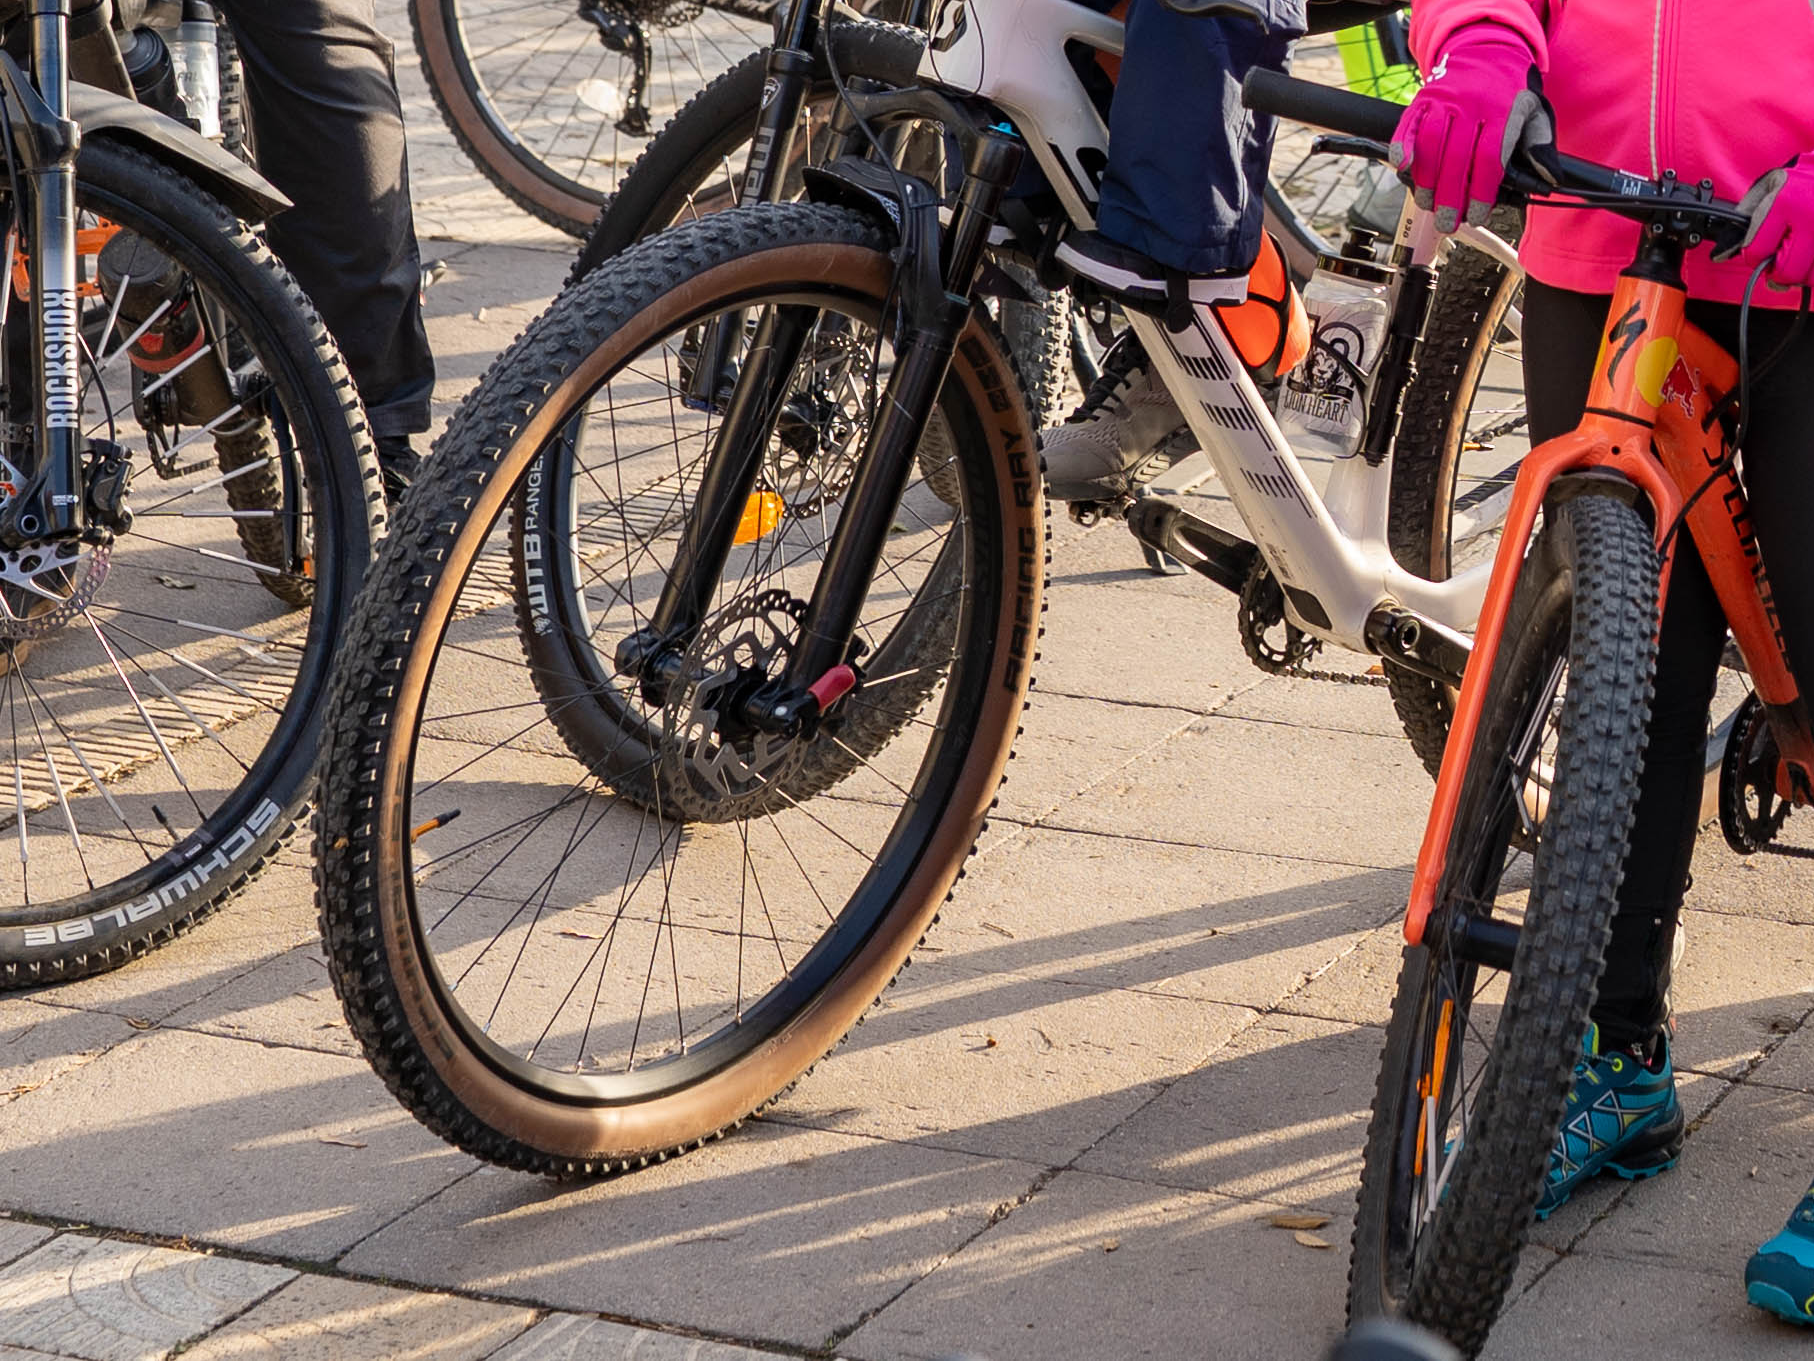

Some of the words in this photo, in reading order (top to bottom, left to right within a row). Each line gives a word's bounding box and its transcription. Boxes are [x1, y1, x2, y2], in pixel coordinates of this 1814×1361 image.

[43, 291, 79, 428] ROCKSHOX
[524, 454, 543, 531] RANGE
[1003, 426, 1034, 509] RAY
[523, 532, 550, 619] WTB
[24, 797, 282, 948] SCHWALBE
